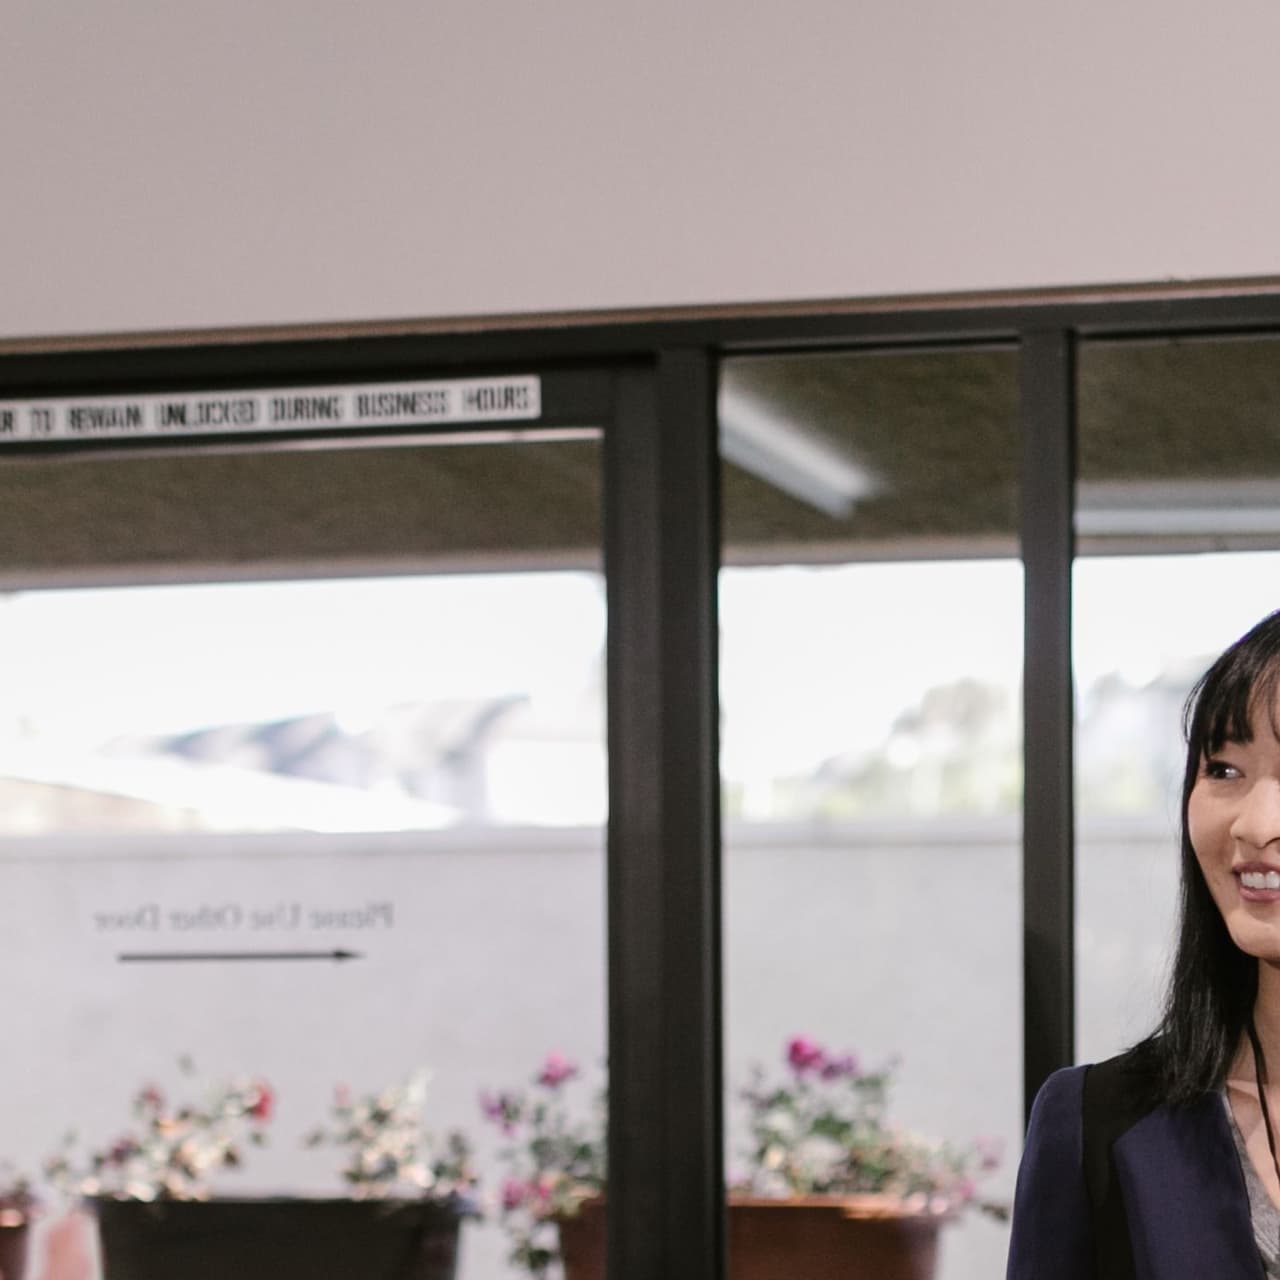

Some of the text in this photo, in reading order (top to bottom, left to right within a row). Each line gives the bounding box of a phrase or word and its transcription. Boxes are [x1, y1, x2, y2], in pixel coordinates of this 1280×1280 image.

[31, 408, 53, 433] TO
[69, 403, 143, 431] REMAIN
[160, 397, 257, 428] UNLOCKED
[268, 394, 343, 421] DURING
[355, 389, 450, 418] BUSINESS
[462, 385, 529, 414] HOURS
